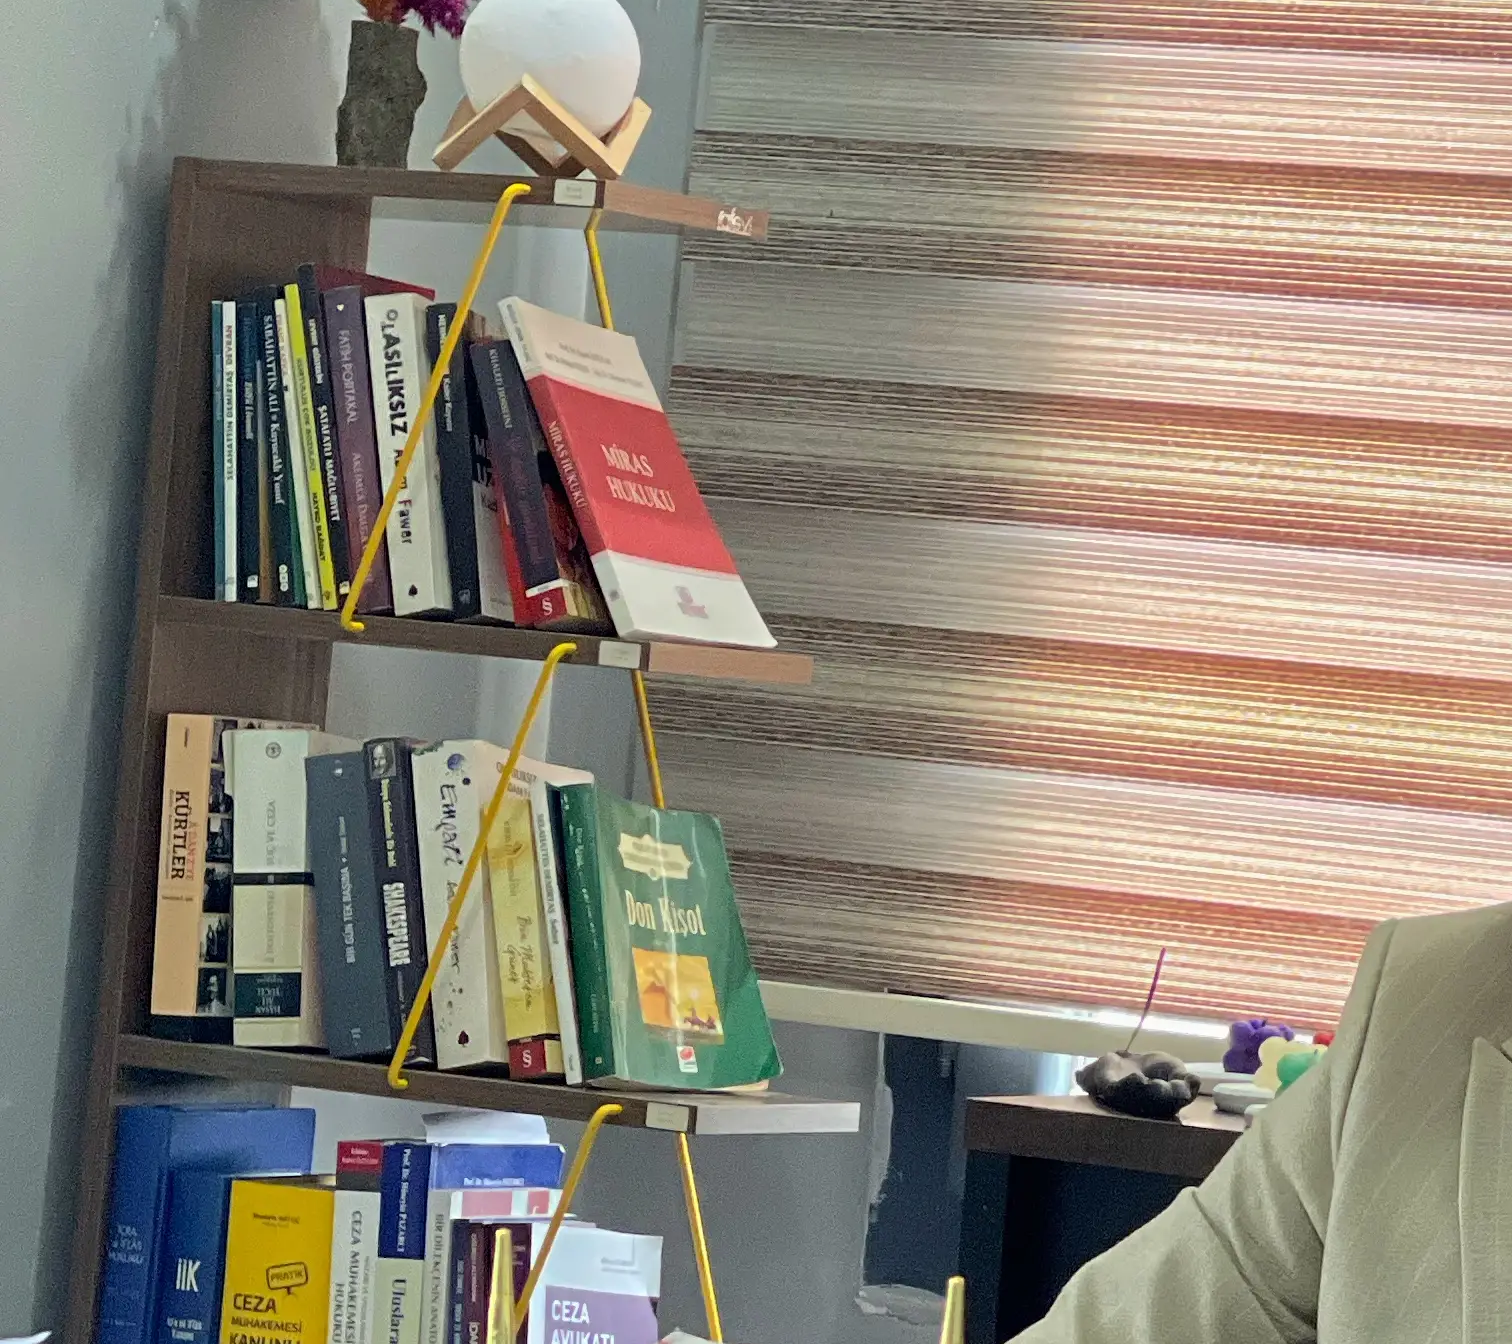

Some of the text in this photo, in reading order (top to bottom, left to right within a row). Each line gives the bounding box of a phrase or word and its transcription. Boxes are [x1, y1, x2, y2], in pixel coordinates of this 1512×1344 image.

[601, 443, 654, 478] MİRAS
[605, 475, 676, 513] HUKUKU
[398, 499, 413, 545] Fawer
[170, 790, 190, 880] KÜRTLER
[625, 888, 656, 931] Don
[658, 896, 707, 938] Kişot
[233, 1292, 278, 1314] CEZA
[551, 1298, 590, 1325] CEZA
